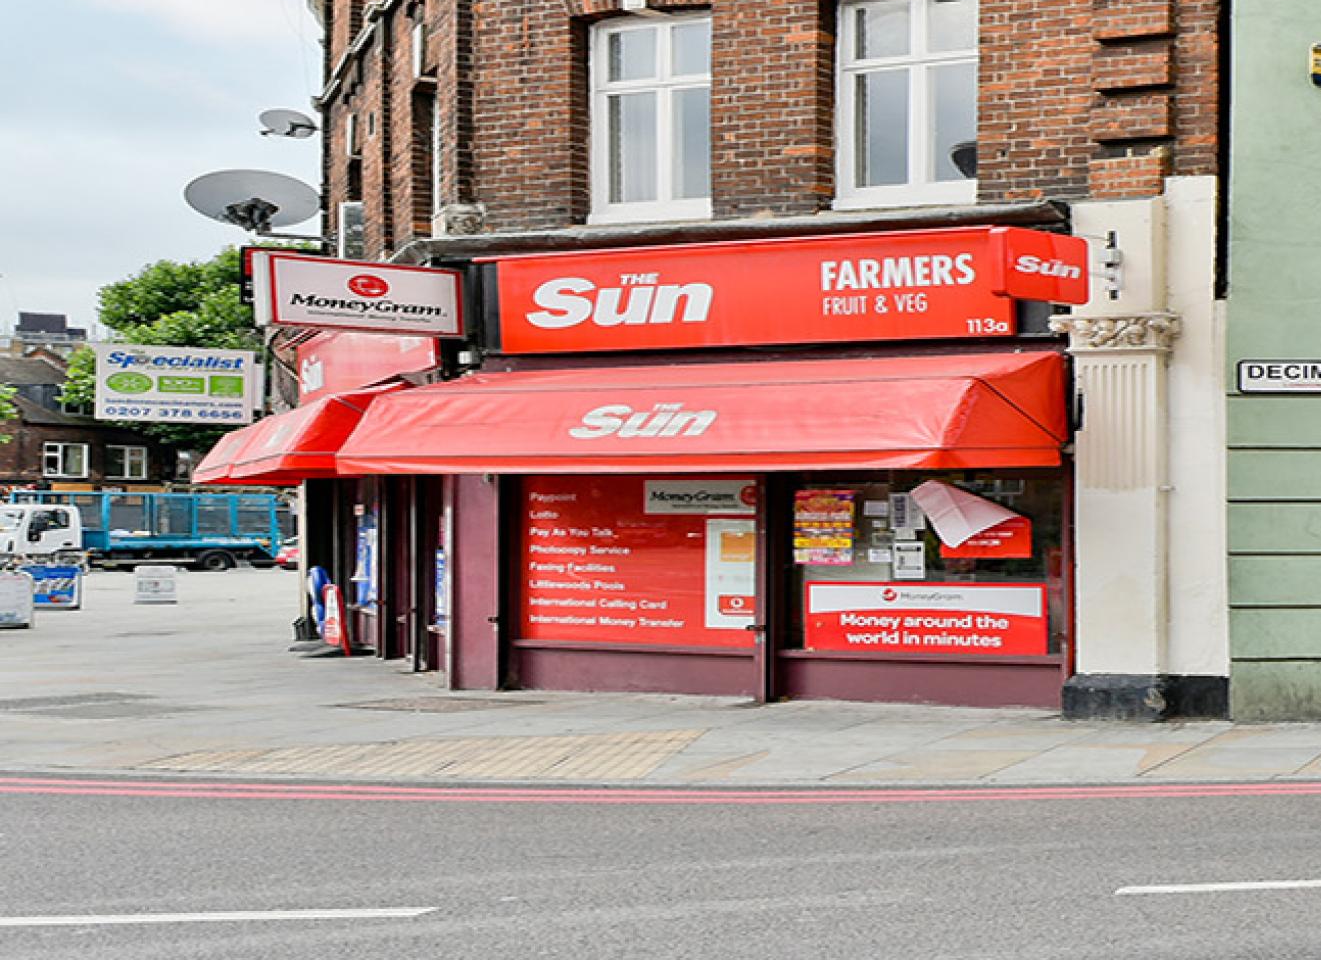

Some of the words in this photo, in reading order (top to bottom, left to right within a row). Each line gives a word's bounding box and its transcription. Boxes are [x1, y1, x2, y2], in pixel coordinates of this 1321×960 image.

[821, 253, 976, 291] FARMERS
[1015, 255, 1081, 279] Sun
[620, 273, 660, 285] THE
[290, 292, 445, 317] MoneyGram
[526, 277, 714, 329] Sun
[822, 295, 868, 316] FRUIT
[874, 296, 889, 314] &
[894, 293, 928, 314] VEG
[966, 318, 1009, 334] 113a
[105, 405, 151, 417] 0207
[653, 402, 684, 412] THE
[569, 405, 718, 440] Sun
[529, 491, 577, 504] Paypoint
[649, 491, 737, 504] MoneyGram
[529, 527, 549, 538] Pay
[570, 528, 589, 538] You
[529, 544, 587, 557] Photocopy
[590, 544, 631, 556] Service
[529, 562, 565, 574] Faxing
[568, 562, 616, 574] Facilities
[529, 579, 592, 591] Littlewoods
[594, 580, 625, 591] Pools
[529, 597, 597, 608] International
[599, 598, 638, 611] Calling
[639, 599, 667, 610] Card
[900, 592, 963, 602] MoneyGram
[529, 614, 597, 625] International
[599, 616, 636, 628] Money
[638, 617, 685, 628] Transfer
[840, 613, 900, 630] Money
[904, 614, 972, 630] around
[976, 615, 1009, 630] the
[846, 631, 900, 645] world
[903, 631, 920, 646] in
[924, 632, 1003, 648] minutes
